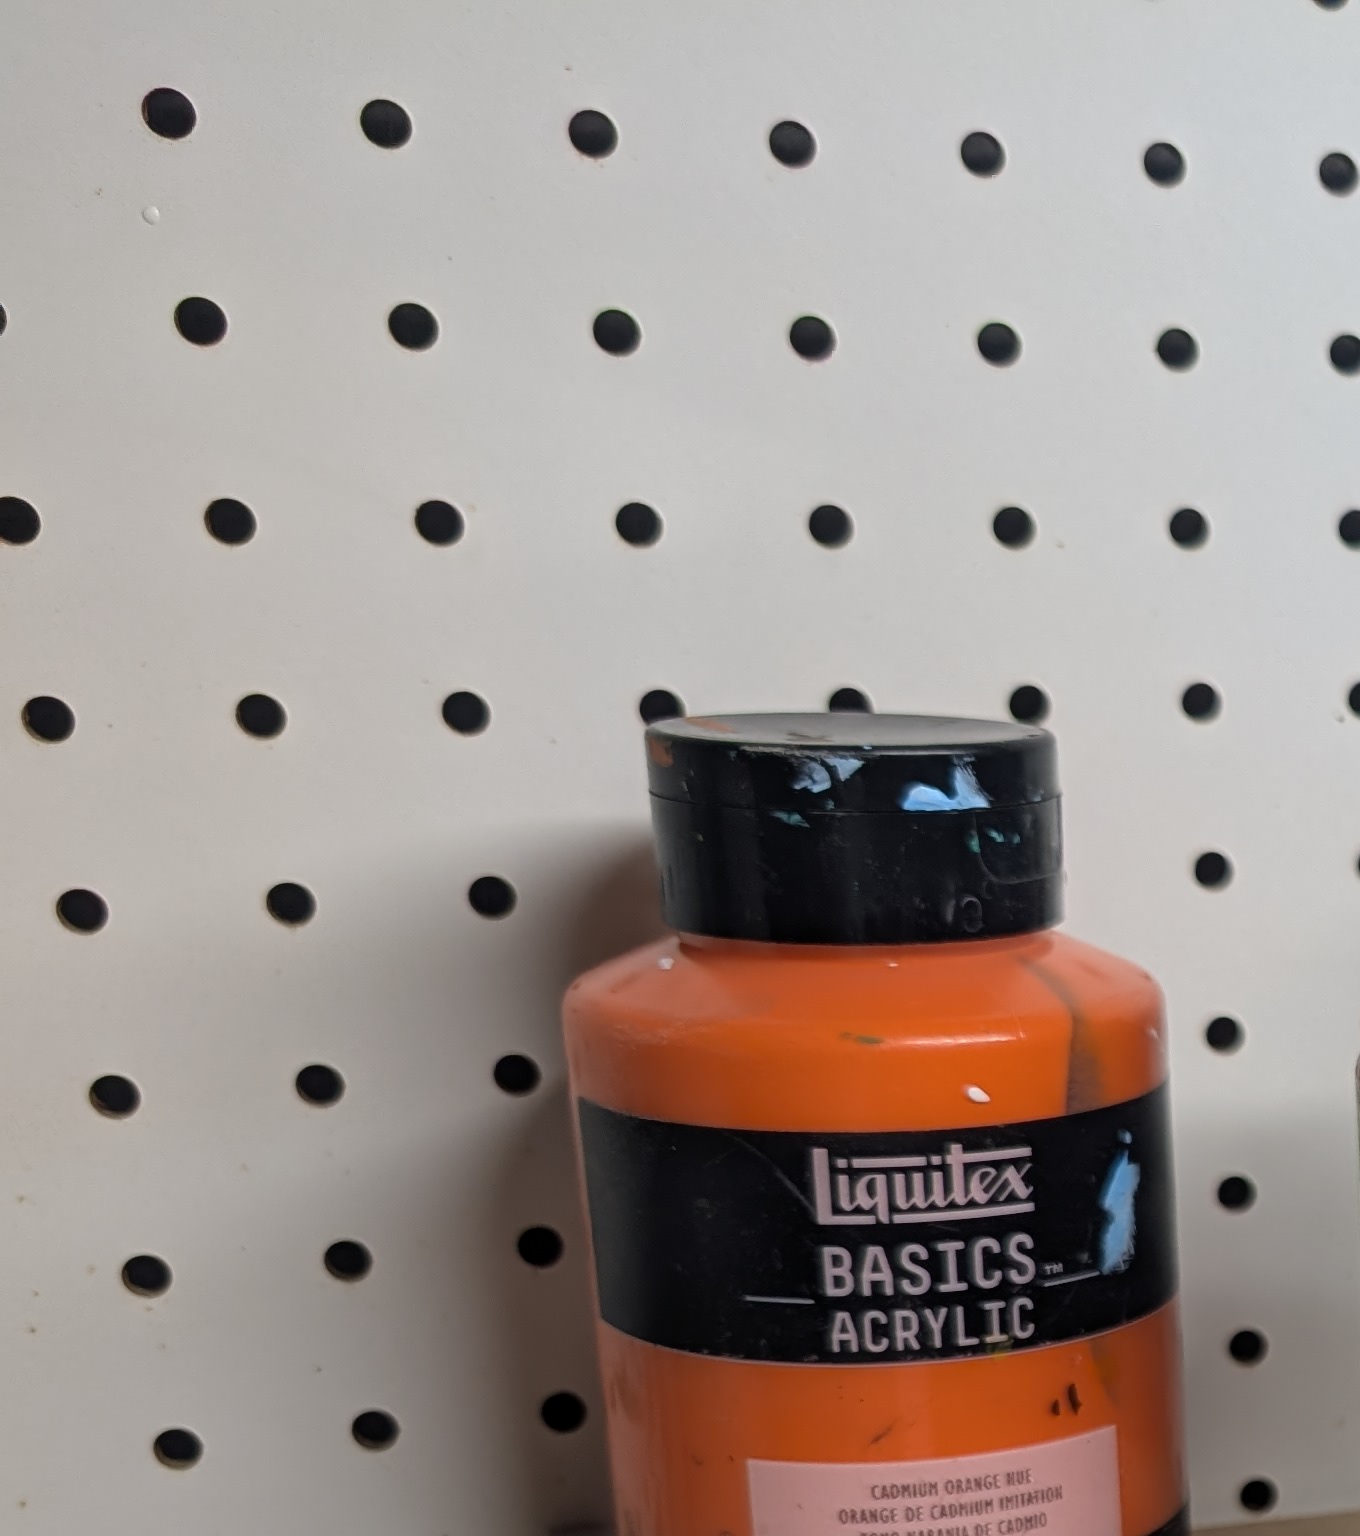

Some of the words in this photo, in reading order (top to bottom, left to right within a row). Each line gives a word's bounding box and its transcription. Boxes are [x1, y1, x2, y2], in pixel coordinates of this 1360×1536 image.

[811, 1143, 1035, 1225] Liquitex
[822, 1232, 1037, 1298] BASICS
[831, 1297, 1036, 1353] ACRYLIC
[838, 1507, 898, 1525] ORANGE
[904, 1505, 924, 1523] DE
[930, 1499, 994, 1520] CADMIUM
[1000, 1484, 1064, 1511] IMITATION
[871, 1481, 938, 1500] CADMIUM
[944, 1474, 1001, 1496] ORANGE
[1006, 1468, 1033, 1486] HUE
[999, 1512, 1048, 1536] CADMIO
